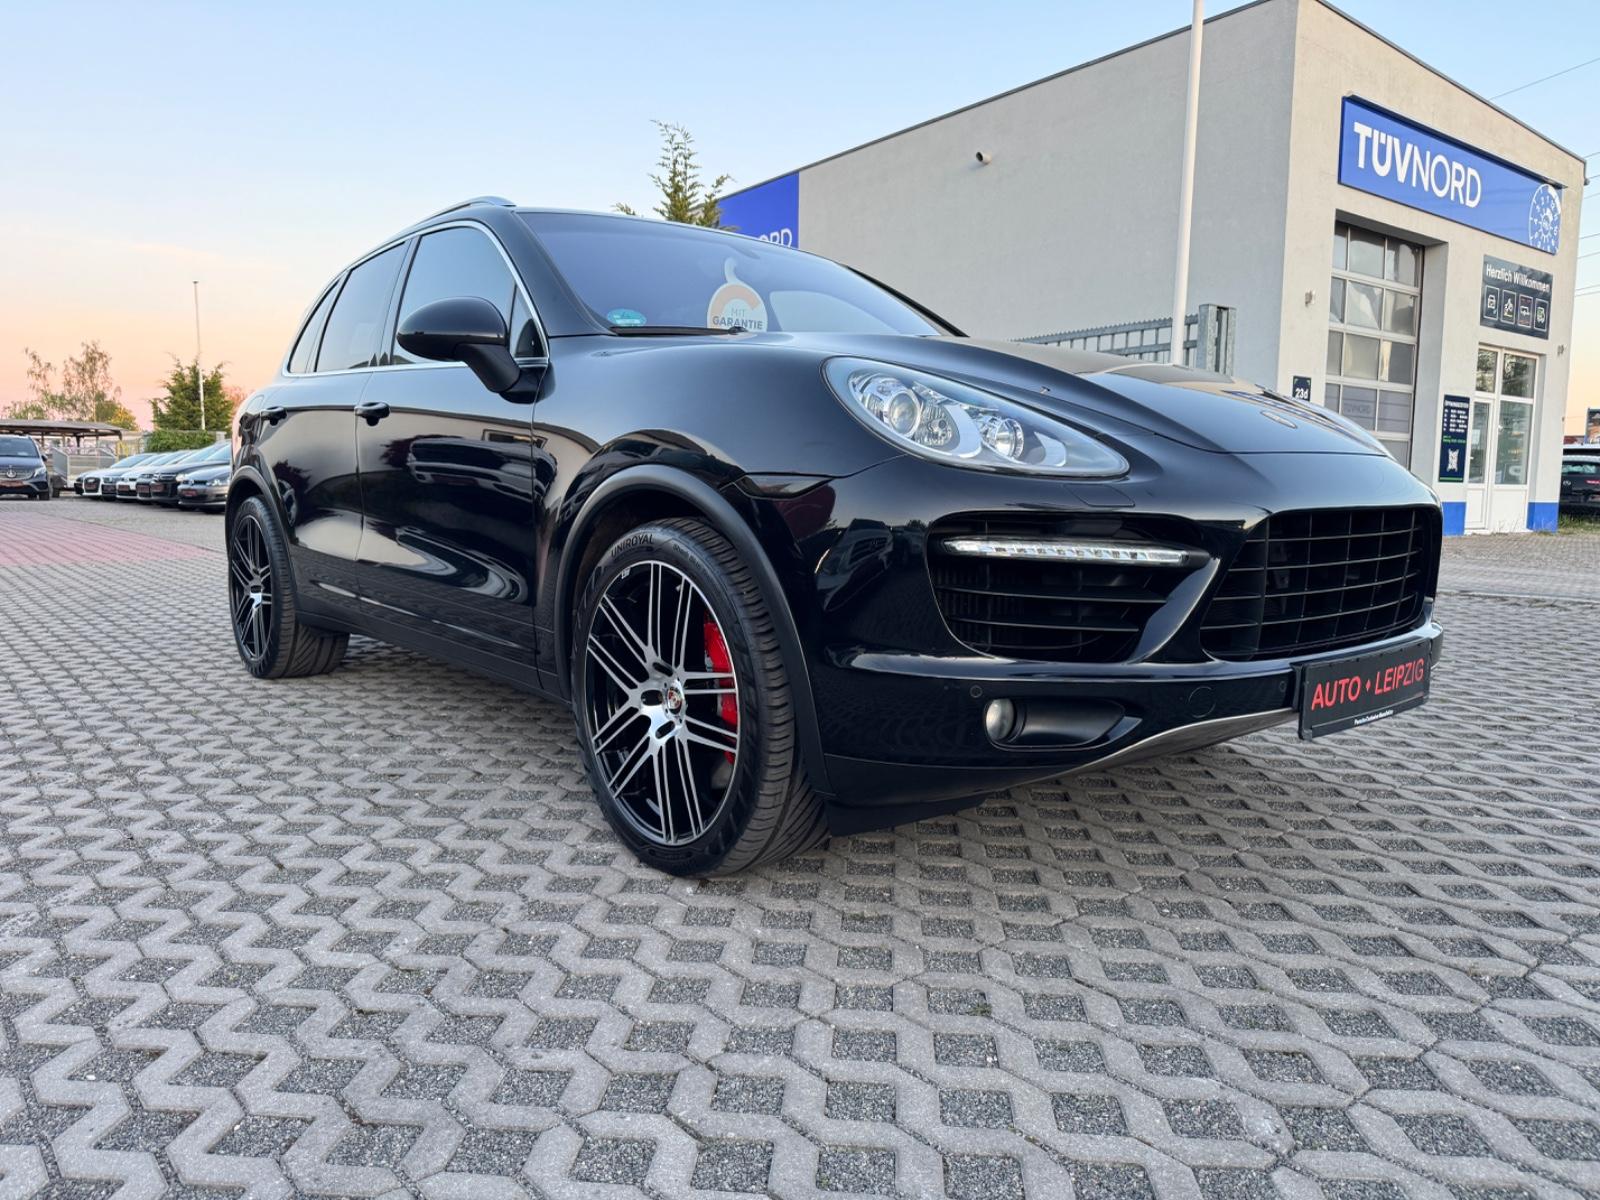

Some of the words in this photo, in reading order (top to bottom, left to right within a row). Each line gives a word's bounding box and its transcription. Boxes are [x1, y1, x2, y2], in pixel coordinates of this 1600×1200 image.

[1486, 263, 1512, 283] Herzlich
[712, 315, 763, 330] GARANTIE
[1295, 387, 1309, 399] 23d
[611, 533, 654, 557] UNIROYAL
[1311, 676, 1361, 711] AUTO
[1374, 658, 1424, 695] LEIPZIG
